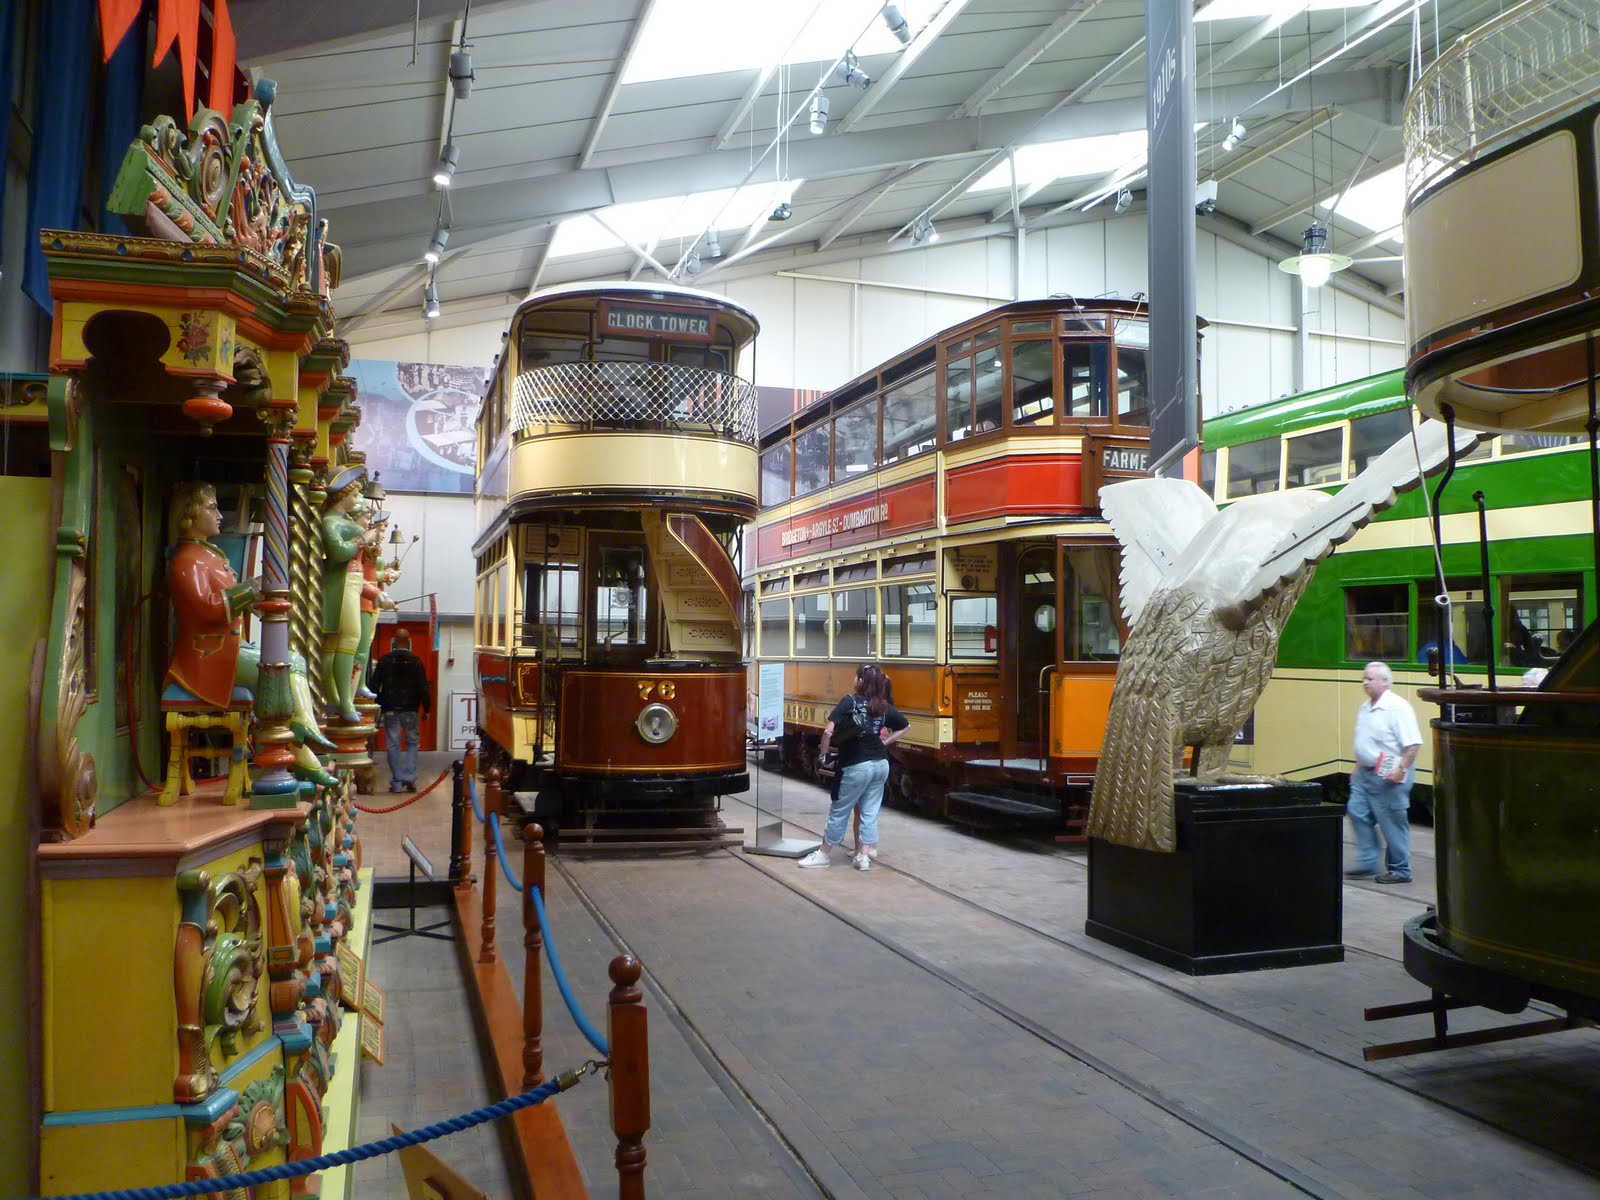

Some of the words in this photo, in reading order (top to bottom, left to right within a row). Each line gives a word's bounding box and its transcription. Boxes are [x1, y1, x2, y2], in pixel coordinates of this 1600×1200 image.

[1153, 46, 1176, 130] 1910s
[660, 316, 708, 335] TOWER
[1103, 450, 1148, 471] FARME
[843, 507, 880, 530] DUMBARTON
[638, 680, 676, 701] 76
[784, 704, 816, 722] ASGOW
